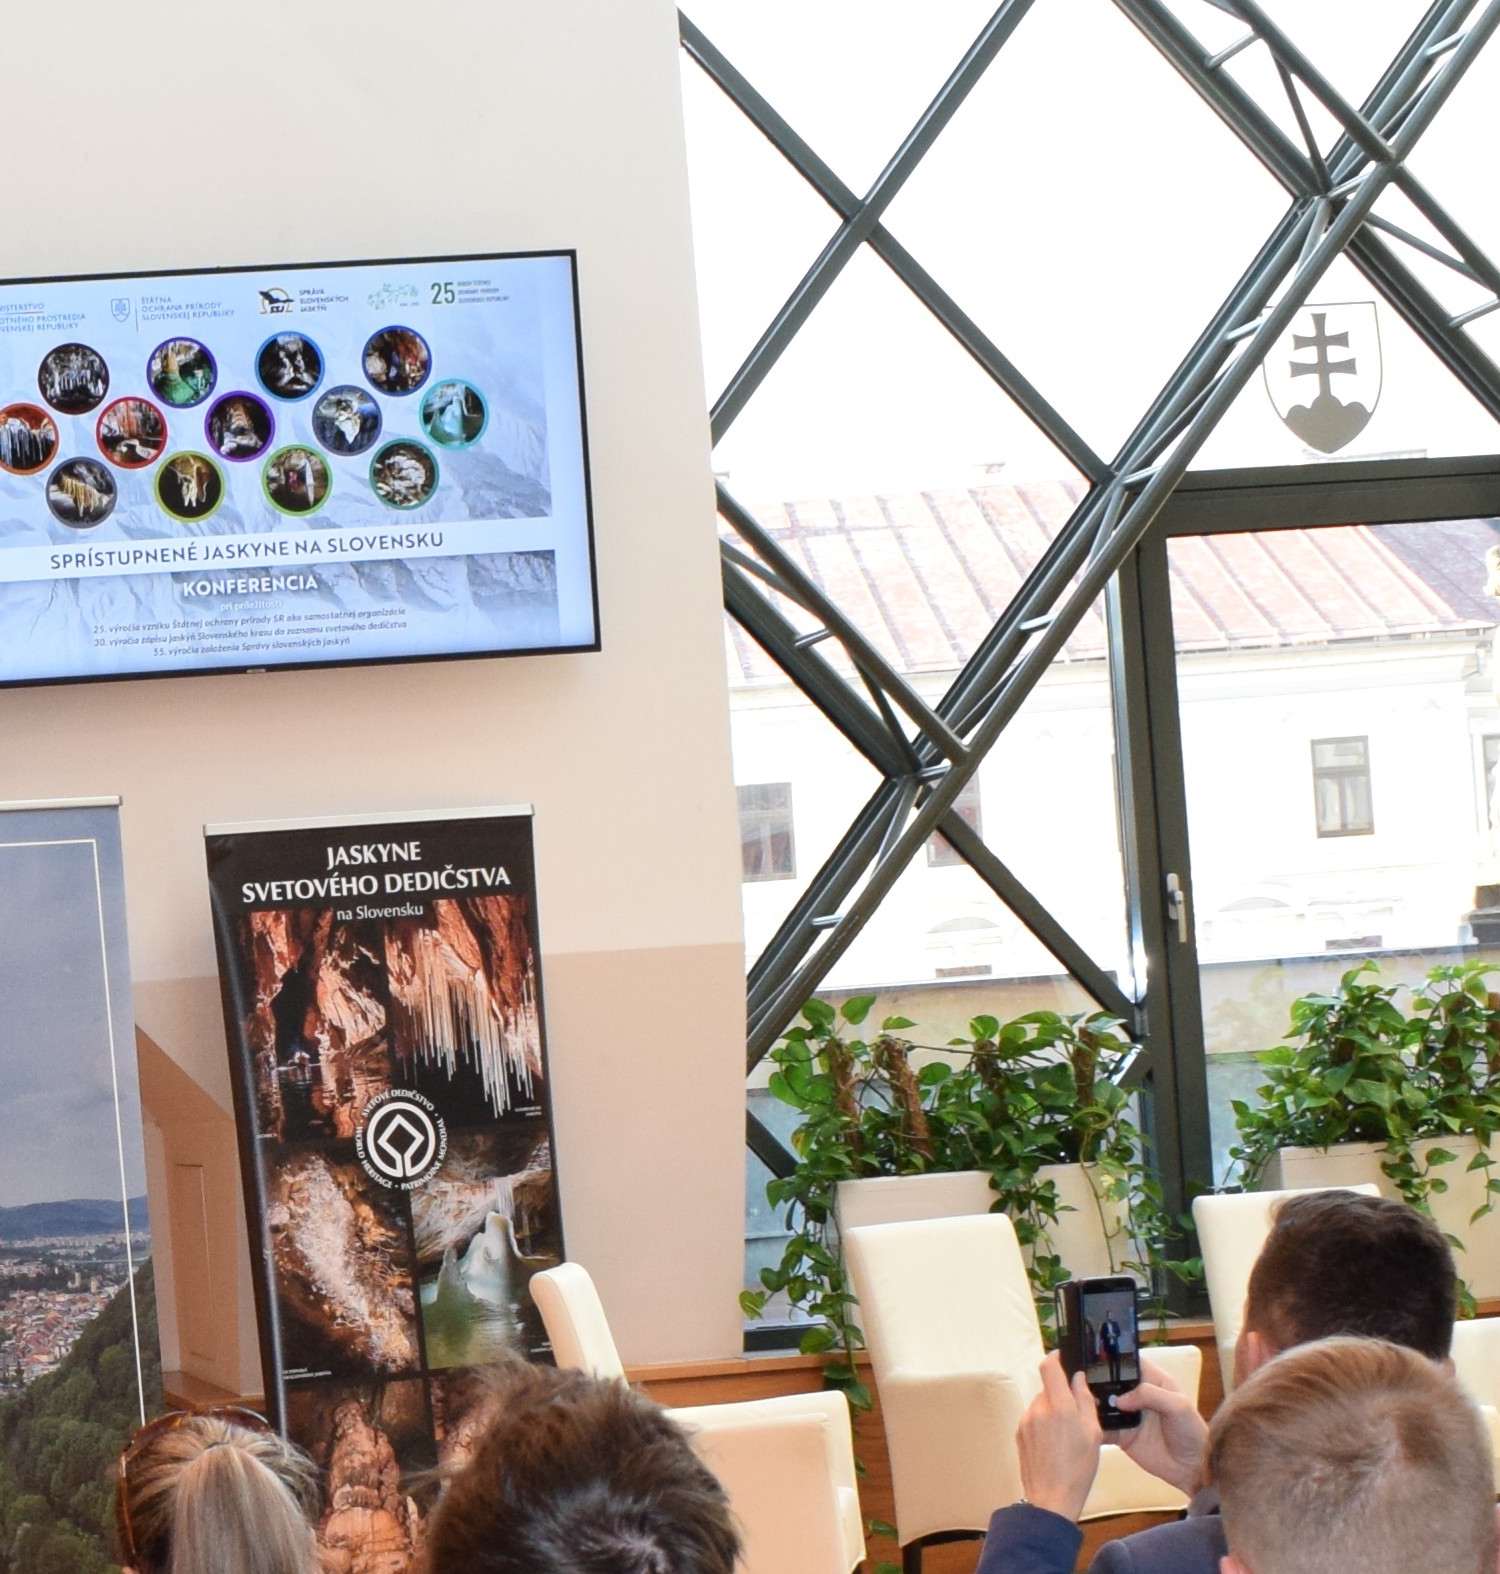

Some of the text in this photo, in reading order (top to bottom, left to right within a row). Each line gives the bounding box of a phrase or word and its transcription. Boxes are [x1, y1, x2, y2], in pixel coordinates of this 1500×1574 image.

[430, 281, 456, 305] 25
[50, 531, 444, 571] SPRÍSTUPNENÉ JASKYNE NA SLOVENSKU
[183, 575, 319, 597] KONFERENCIA
[326, 841, 422, 870] JASKYNE
[241, 864, 512, 903] SVETOVÉHO DEDIČSTVA
[336, 902, 424, 921] na Slovensku
